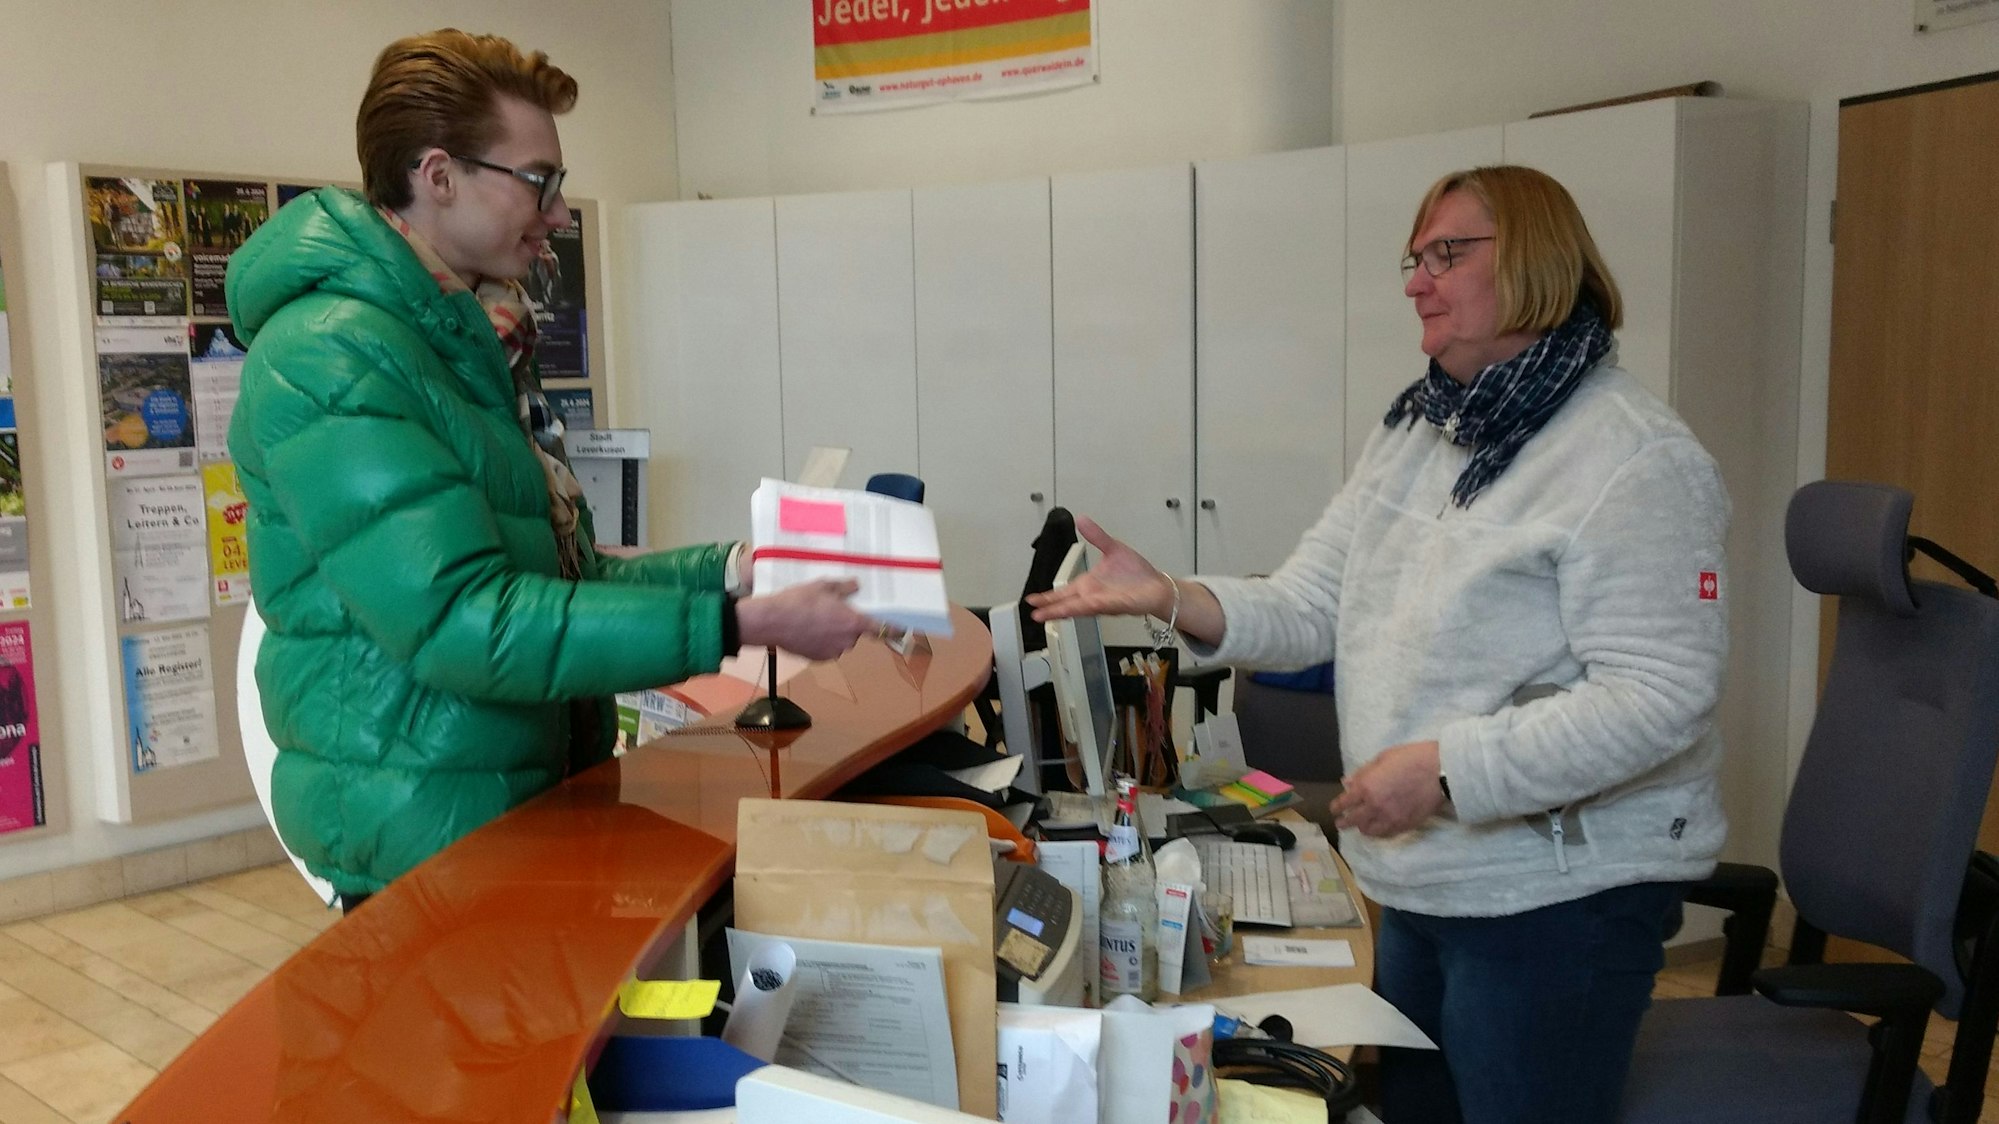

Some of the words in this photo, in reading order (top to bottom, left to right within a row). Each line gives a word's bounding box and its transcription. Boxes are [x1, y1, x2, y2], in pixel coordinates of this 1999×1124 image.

[589, 432, 612, 441] Stadt
[576, 445, 626, 454] Leverkusen
[139, 503, 187, 516] Treppen,
[127, 517, 169, 530] Leitern
[172, 518, 181, 527] &
[135, 668, 155, 678] Alle
[158, 658, 202, 675] Register!
